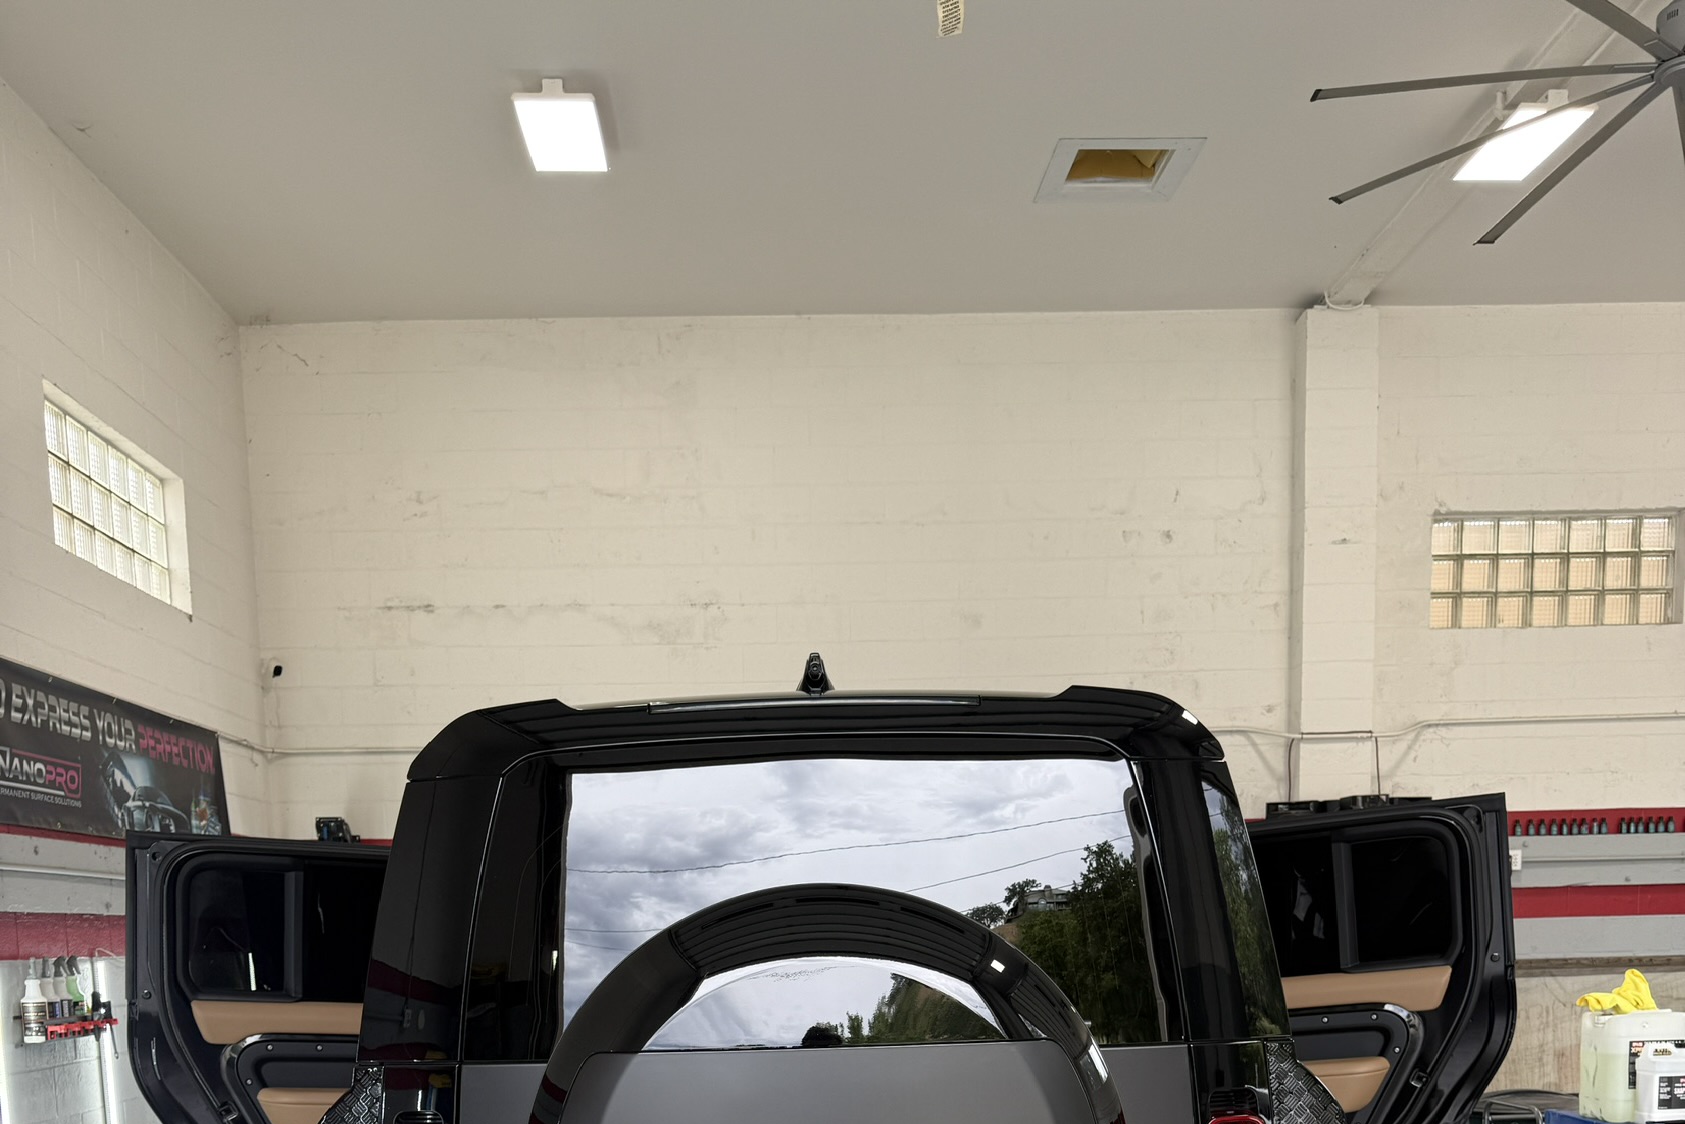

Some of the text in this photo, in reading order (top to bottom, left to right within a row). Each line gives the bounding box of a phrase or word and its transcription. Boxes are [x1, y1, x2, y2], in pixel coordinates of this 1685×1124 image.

[11, 682, 92, 742] EXPRESS
[93, 708, 137, 753] YOUR
[0, 787, 82, 808] RMANENT SURFACE SOLUTIONS
